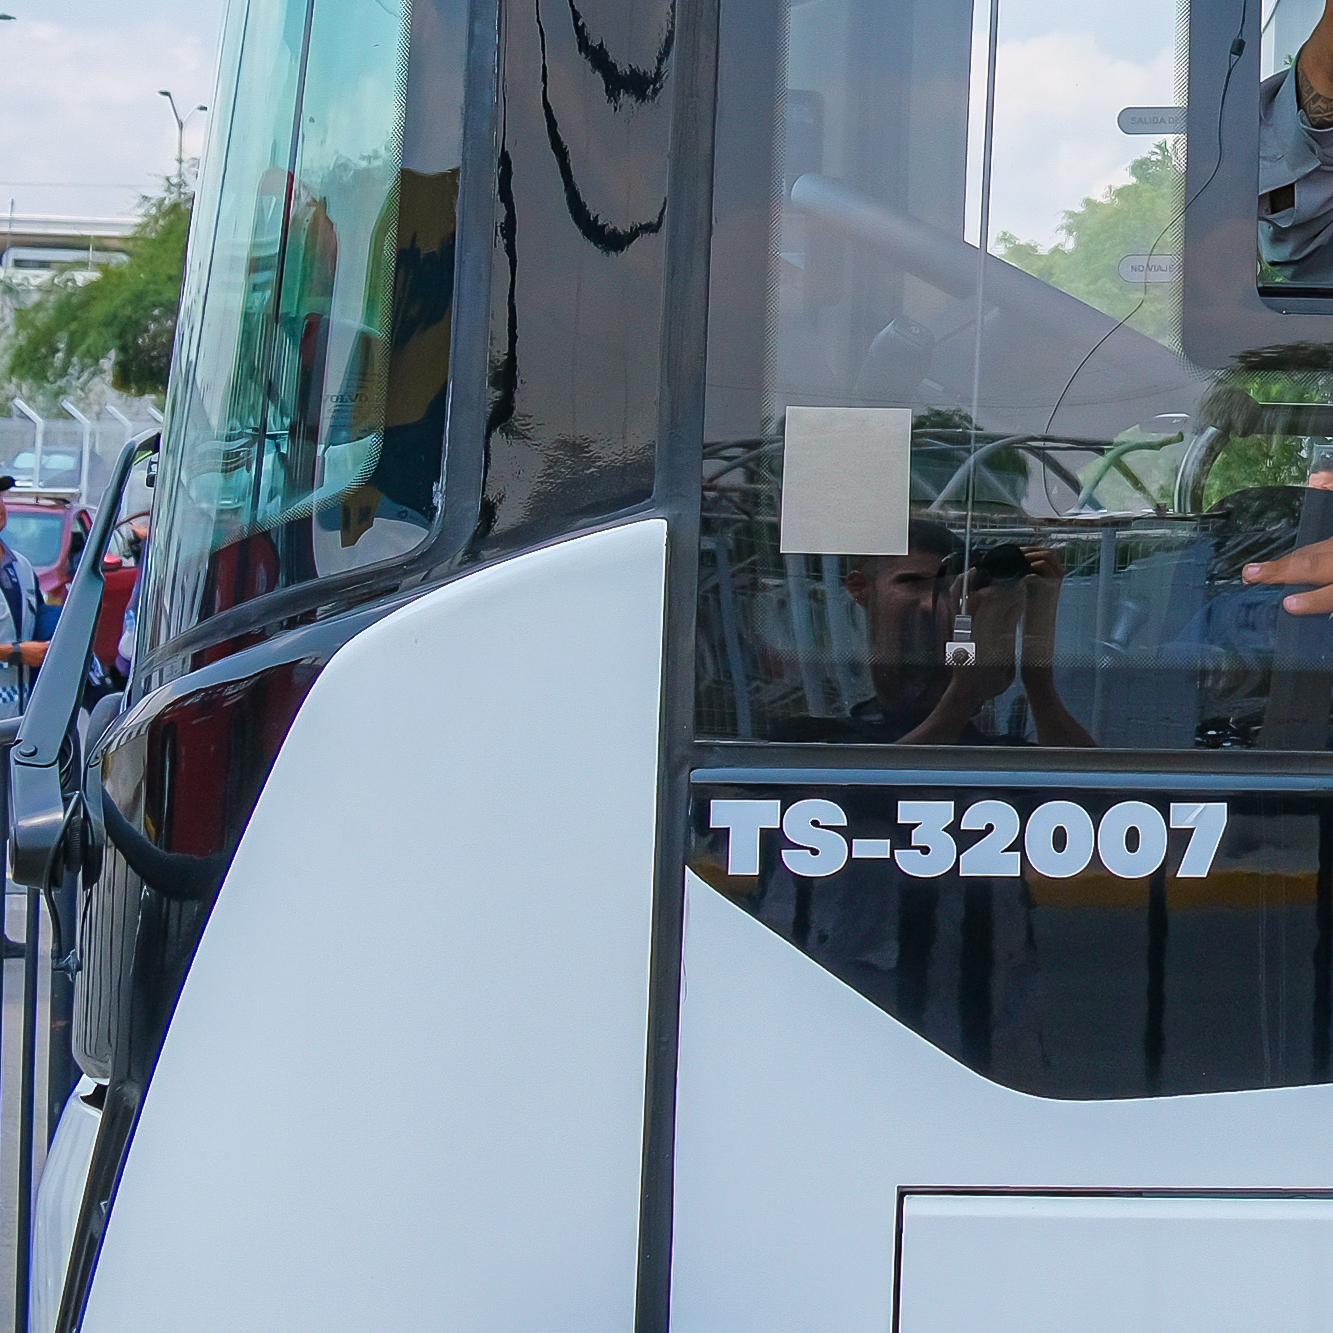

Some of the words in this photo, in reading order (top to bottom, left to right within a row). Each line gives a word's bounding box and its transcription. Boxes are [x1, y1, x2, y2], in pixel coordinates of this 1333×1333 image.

[1130, 116, 1166, 125] SALIDA
[1130, 264, 1144, 272] NO
[709, 798, 1229, 879] TS-32007
